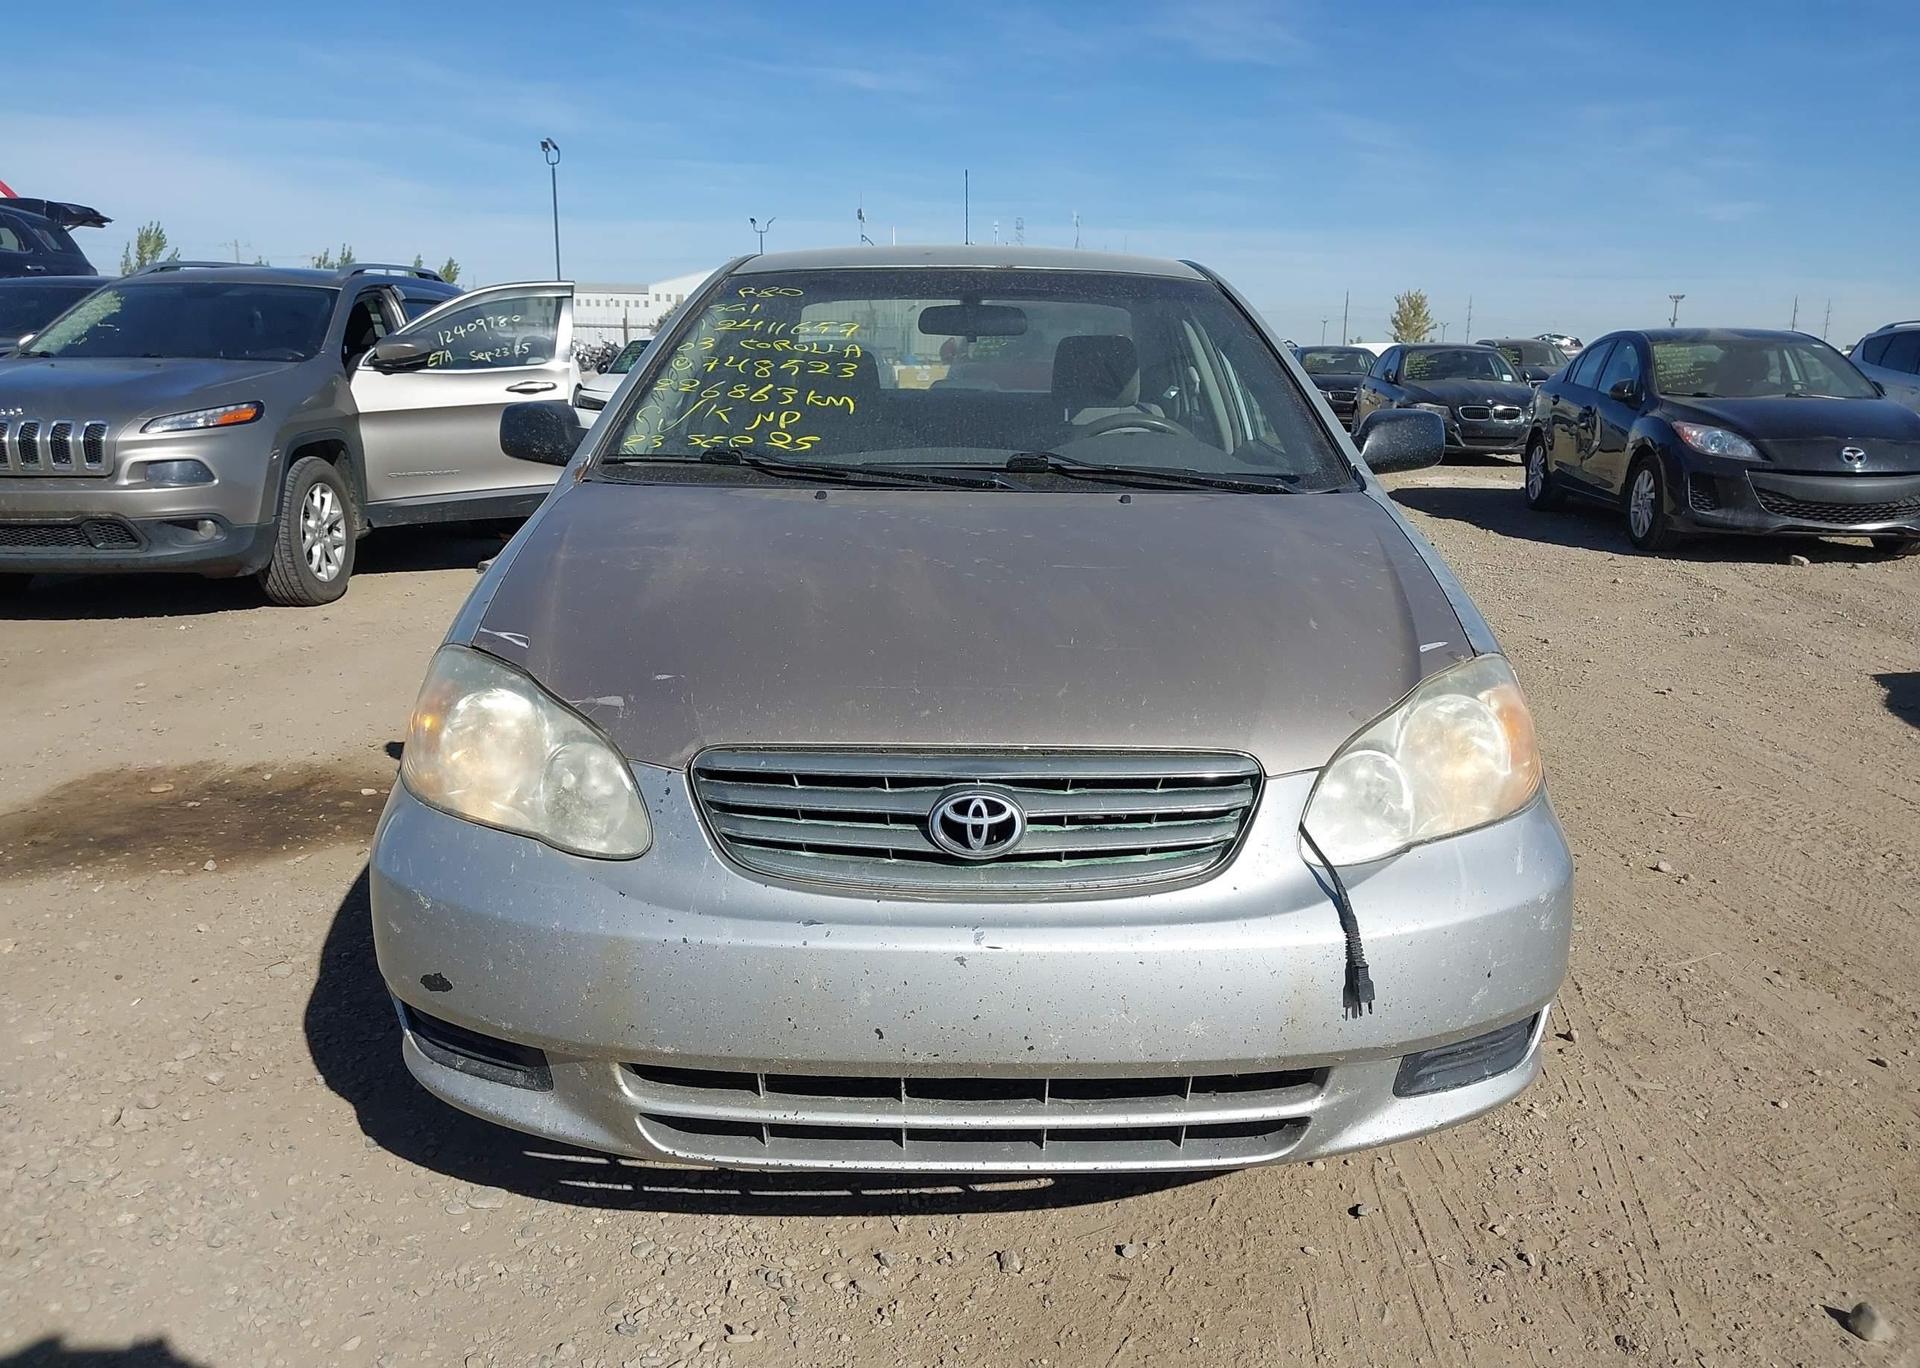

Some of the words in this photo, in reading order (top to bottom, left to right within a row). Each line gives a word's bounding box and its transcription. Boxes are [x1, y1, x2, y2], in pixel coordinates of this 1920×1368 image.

[739, 338, 862, 358] COROLLA
[427, 351, 453, 367] ETA
[765, 431, 821, 452] 25
